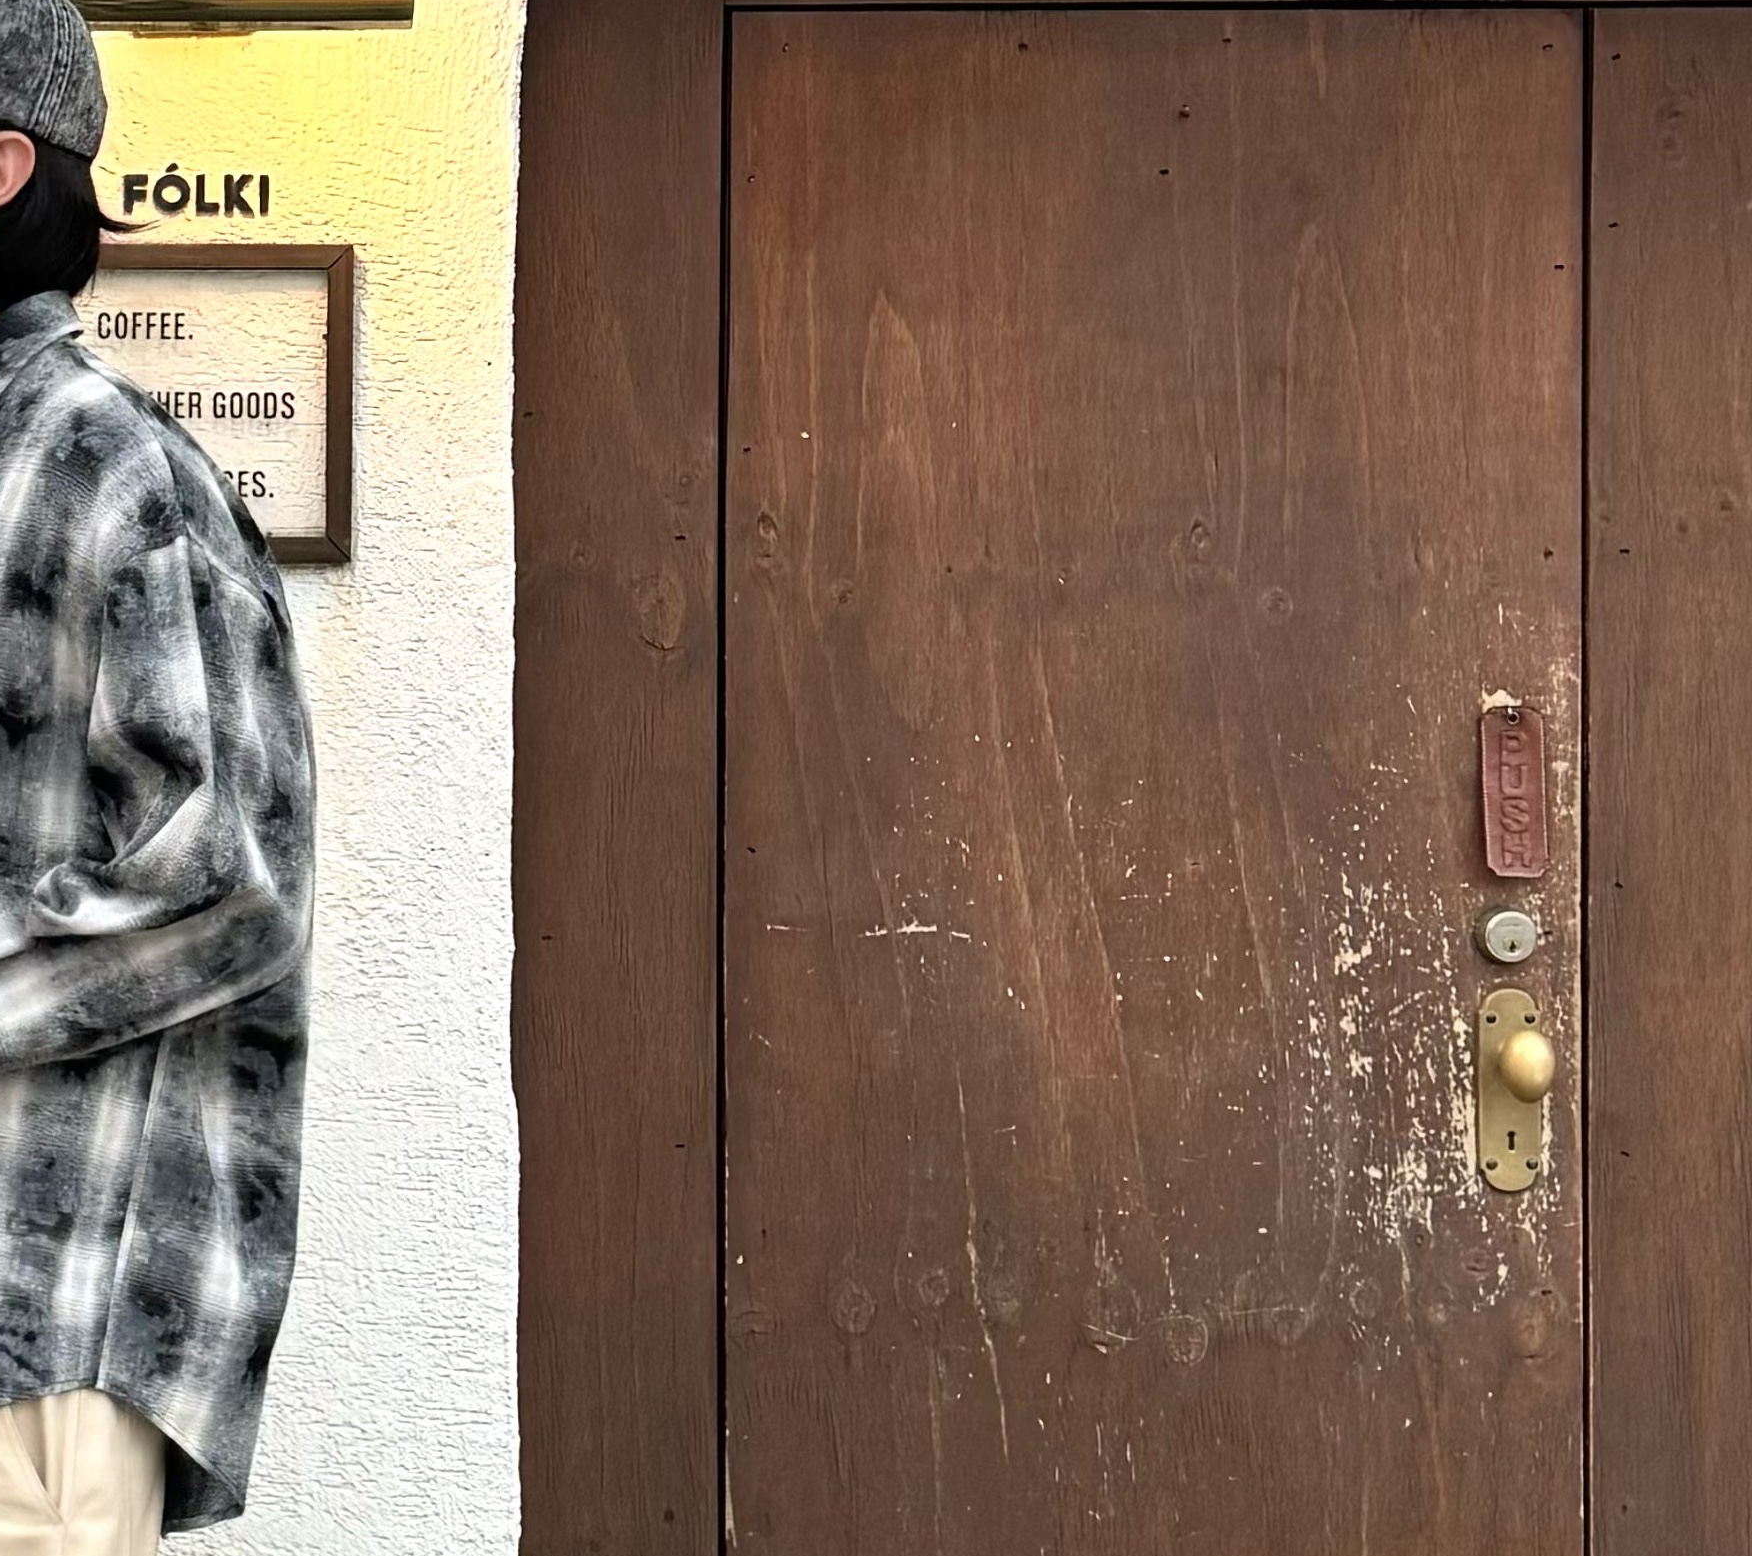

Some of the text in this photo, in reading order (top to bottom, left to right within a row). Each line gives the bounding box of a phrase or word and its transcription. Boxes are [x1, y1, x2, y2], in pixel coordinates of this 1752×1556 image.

[123, 163, 270, 216] FÓLKI
[98, 312, 193, 340] COFFEE.
[150, 391, 295, 419] HER GOODS
[1500, 730, 1532, 869] PUSH
